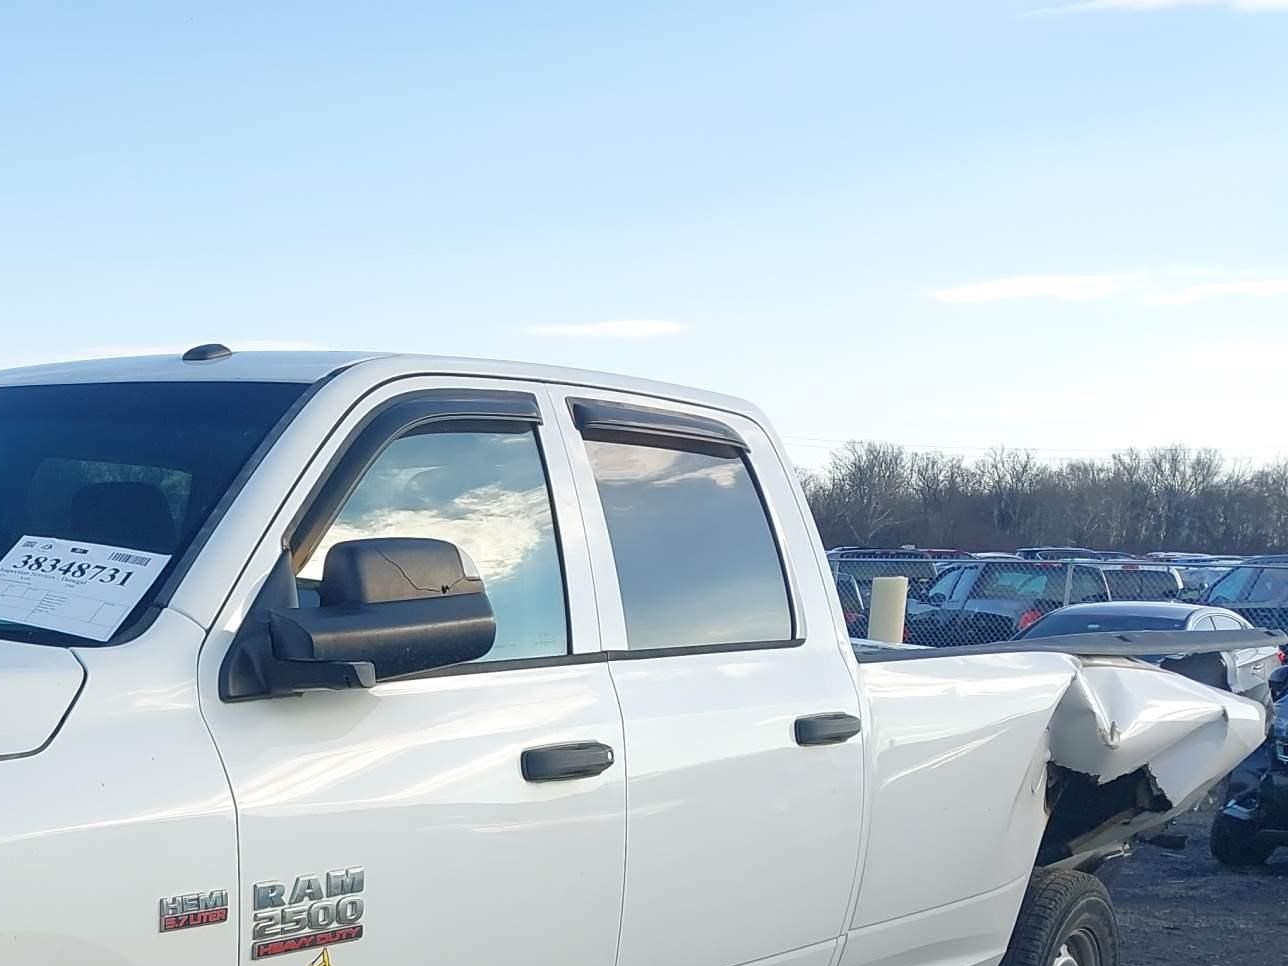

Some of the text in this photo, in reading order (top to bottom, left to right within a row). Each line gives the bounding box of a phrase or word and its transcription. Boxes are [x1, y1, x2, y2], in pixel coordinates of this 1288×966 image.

[13, 554, 135, 587] 38348731
[159, 889, 229, 917] HEMI
[252, 866, 365, 910] RAM
[165, 909, 226, 930] 5.7 LITER
[252, 895, 365, 940] 2500
[259, 926, 363, 957] HEAVY DUTY
